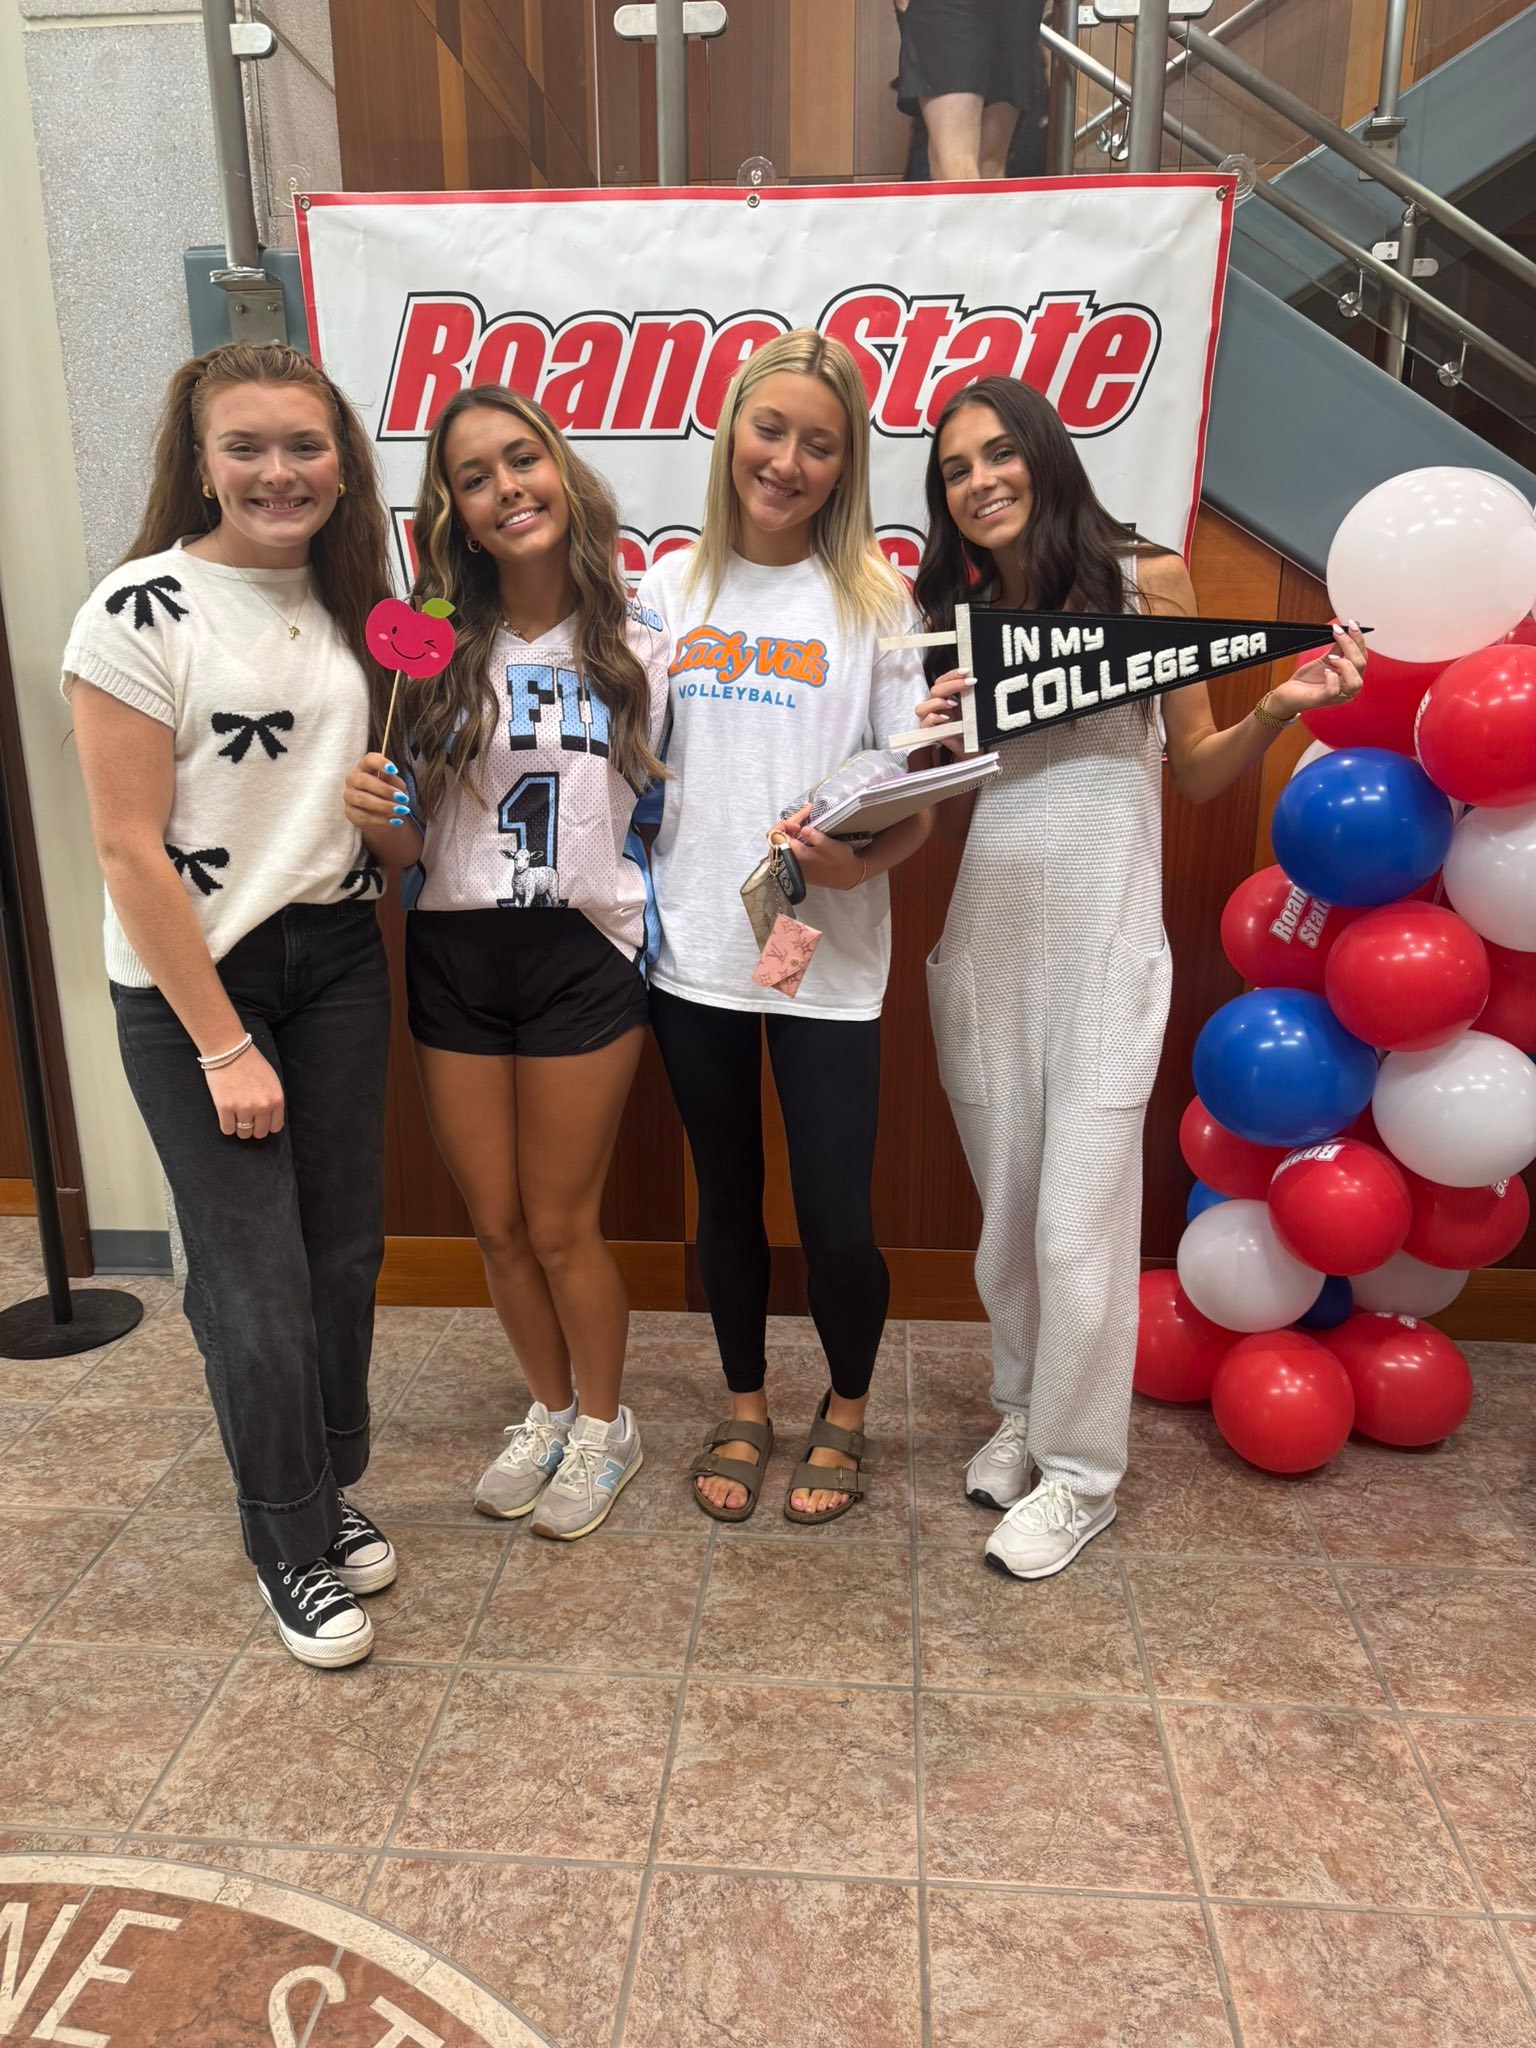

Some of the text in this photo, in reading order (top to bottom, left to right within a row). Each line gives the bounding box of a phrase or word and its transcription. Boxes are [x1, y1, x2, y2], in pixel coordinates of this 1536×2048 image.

[815, 283, 1162, 439] State
[668, 624, 830, 688] Lady Vols
[1001, 623, 1104, 668] IN MY
[678, 683, 796, 709] VOLLEYBALL
[994, 631, 1267, 731] COLLEGE ERA
[497, 771, 569, 908] 1
[1269, 884, 1309, 944] Roan
[1297, 897, 1332, 949] Stat
